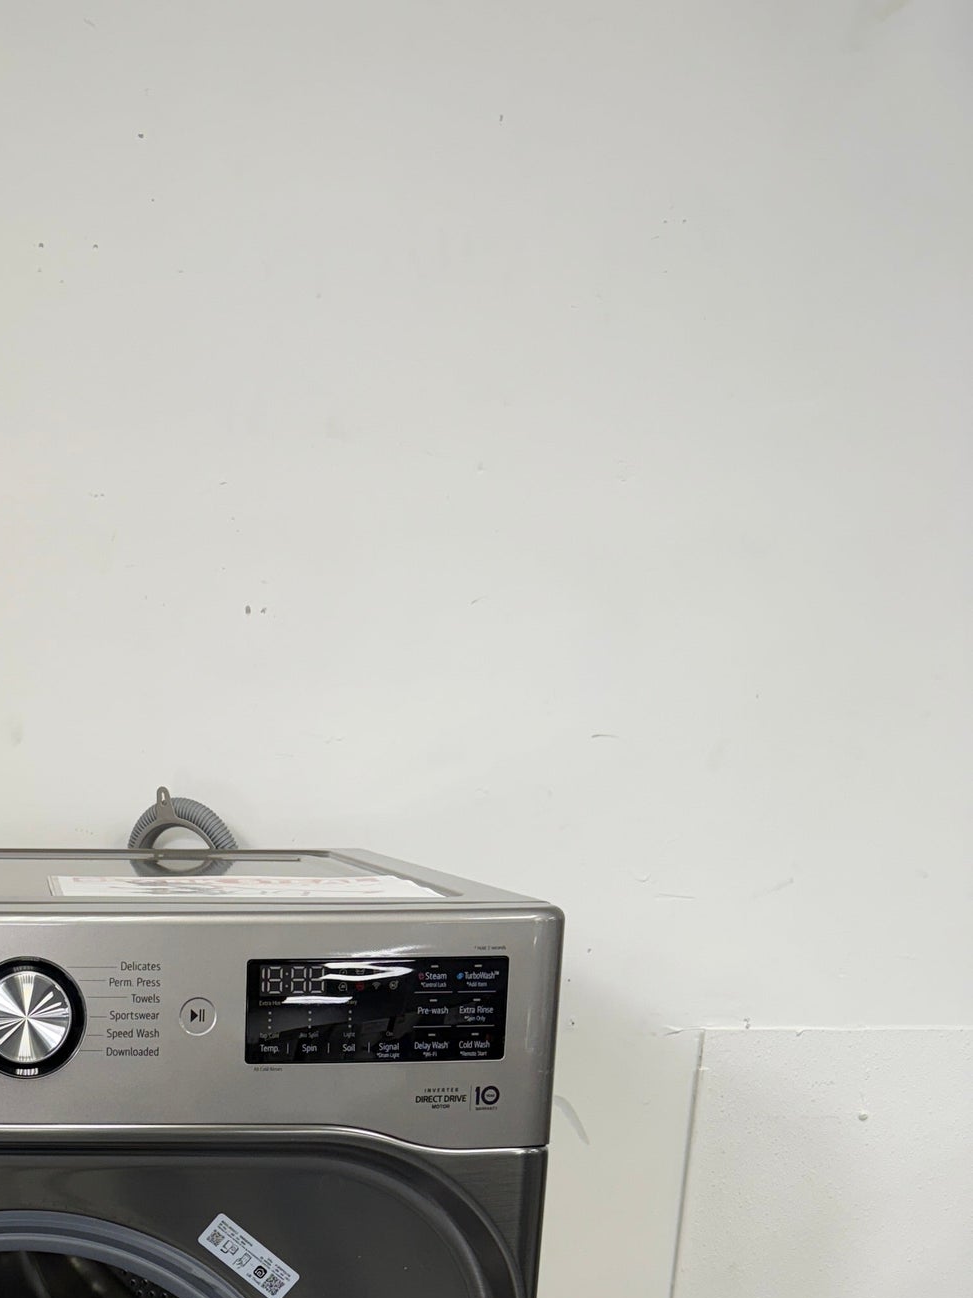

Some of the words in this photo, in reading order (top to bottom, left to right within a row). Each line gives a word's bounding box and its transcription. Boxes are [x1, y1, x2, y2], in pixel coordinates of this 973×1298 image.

[120, 961, 161, 971] Delicates
[425, 972, 447, 980] Steam
[109, 977, 134, 987] Perm.
[136, 977, 161, 987] Press
[131, 993, 160, 1003] Towels
[417, 1006, 449, 1015] Pre-wash
[459, 1006, 475, 1014] Extra
[476, 1005, 494, 1014] Rinse
[109, 1010, 160, 1022] Sportswear
[106, 1028, 134, 1040] Speed
[136, 1028, 160, 1038] Wash
[260, 1044, 279, 1055] Temp.
[302, 1043, 318, 1055] Spin
[342, 1043, 356, 1052] Soil
[378, 1042, 400, 1054] Signal
[414, 1041, 430, 1050] Delay
[432, 1041, 449, 1049] Wash
[458, 1040, 473, 1049] Cold
[474, 1040, 490, 1049] Wash
[106, 1046, 160, 1056] Downloaded
[415, 1095, 443, 1104] DIRECT
[443, 1094, 467, 1103] DRIVE
[475, 1085, 500, 1105] 10
